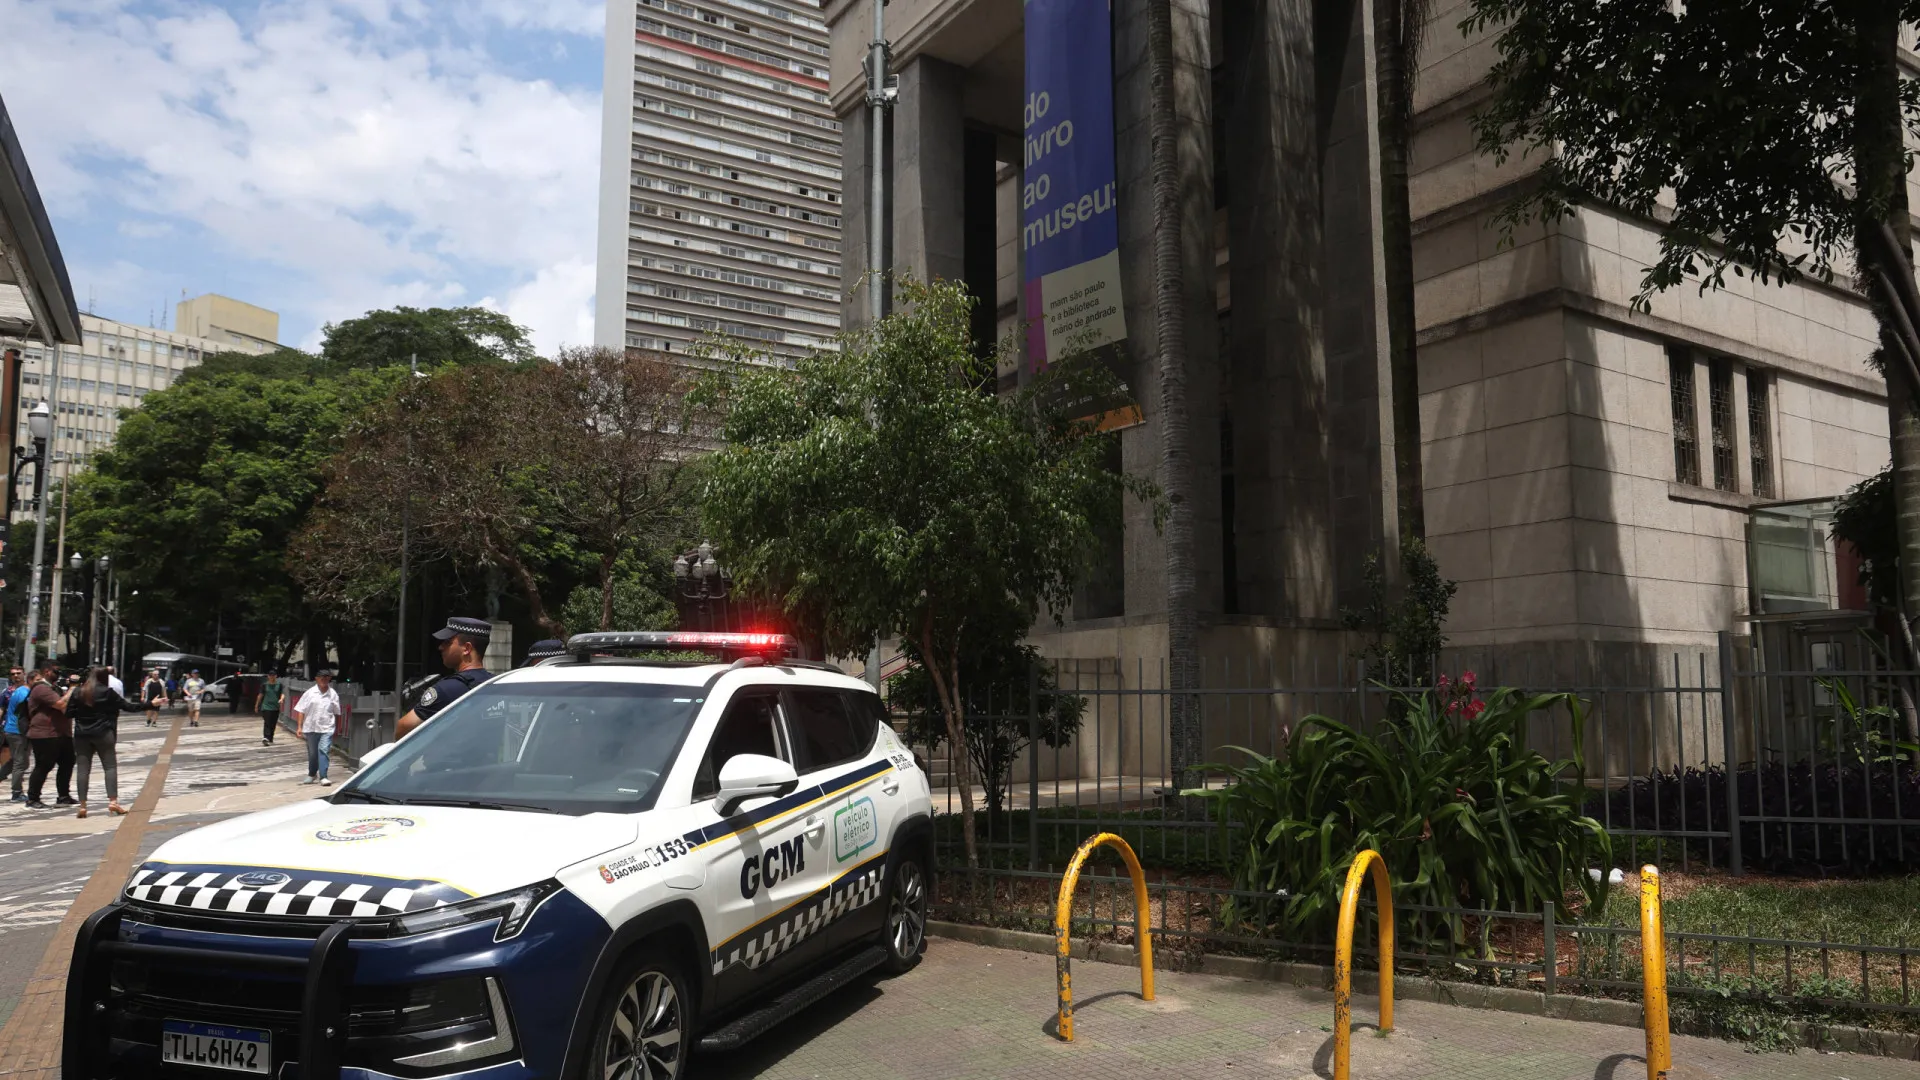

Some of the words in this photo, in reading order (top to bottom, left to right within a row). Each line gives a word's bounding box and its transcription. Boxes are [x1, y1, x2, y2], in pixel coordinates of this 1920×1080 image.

[1024, 91, 1050, 130] do
[1024, 119, 1073, 170] livro
[1024, 173, 1050, 210] ao
[1050, 295, 1068, 311] mam
[1069, 289, 1083, 302] são
[1084, 281, 1106, 298] paulo
[1051, 315, 1056, 323] e
[1057, 312, 1062, 321] a
[1063, 297, 1100, 319] biblioteca
[1074, 317, 1084, 328] de
[1085, 305, 1117, 325] andrade
[843, 805, 868, 828] veículo
[843, 820, 870, 842] elétrico
[608, 858, 627, 871] CIDADE
[628, 855, 637, 864] DE
[655, 838, 687, 863] 153
[243, 871, 282, 882] JAC
[614, 867, 630, 880] SÃO
[628, 860, 650, 874] PAULO
[740, 833, 806, 900] GCM
[171, 1033, 258, 1069] TLL6H42
